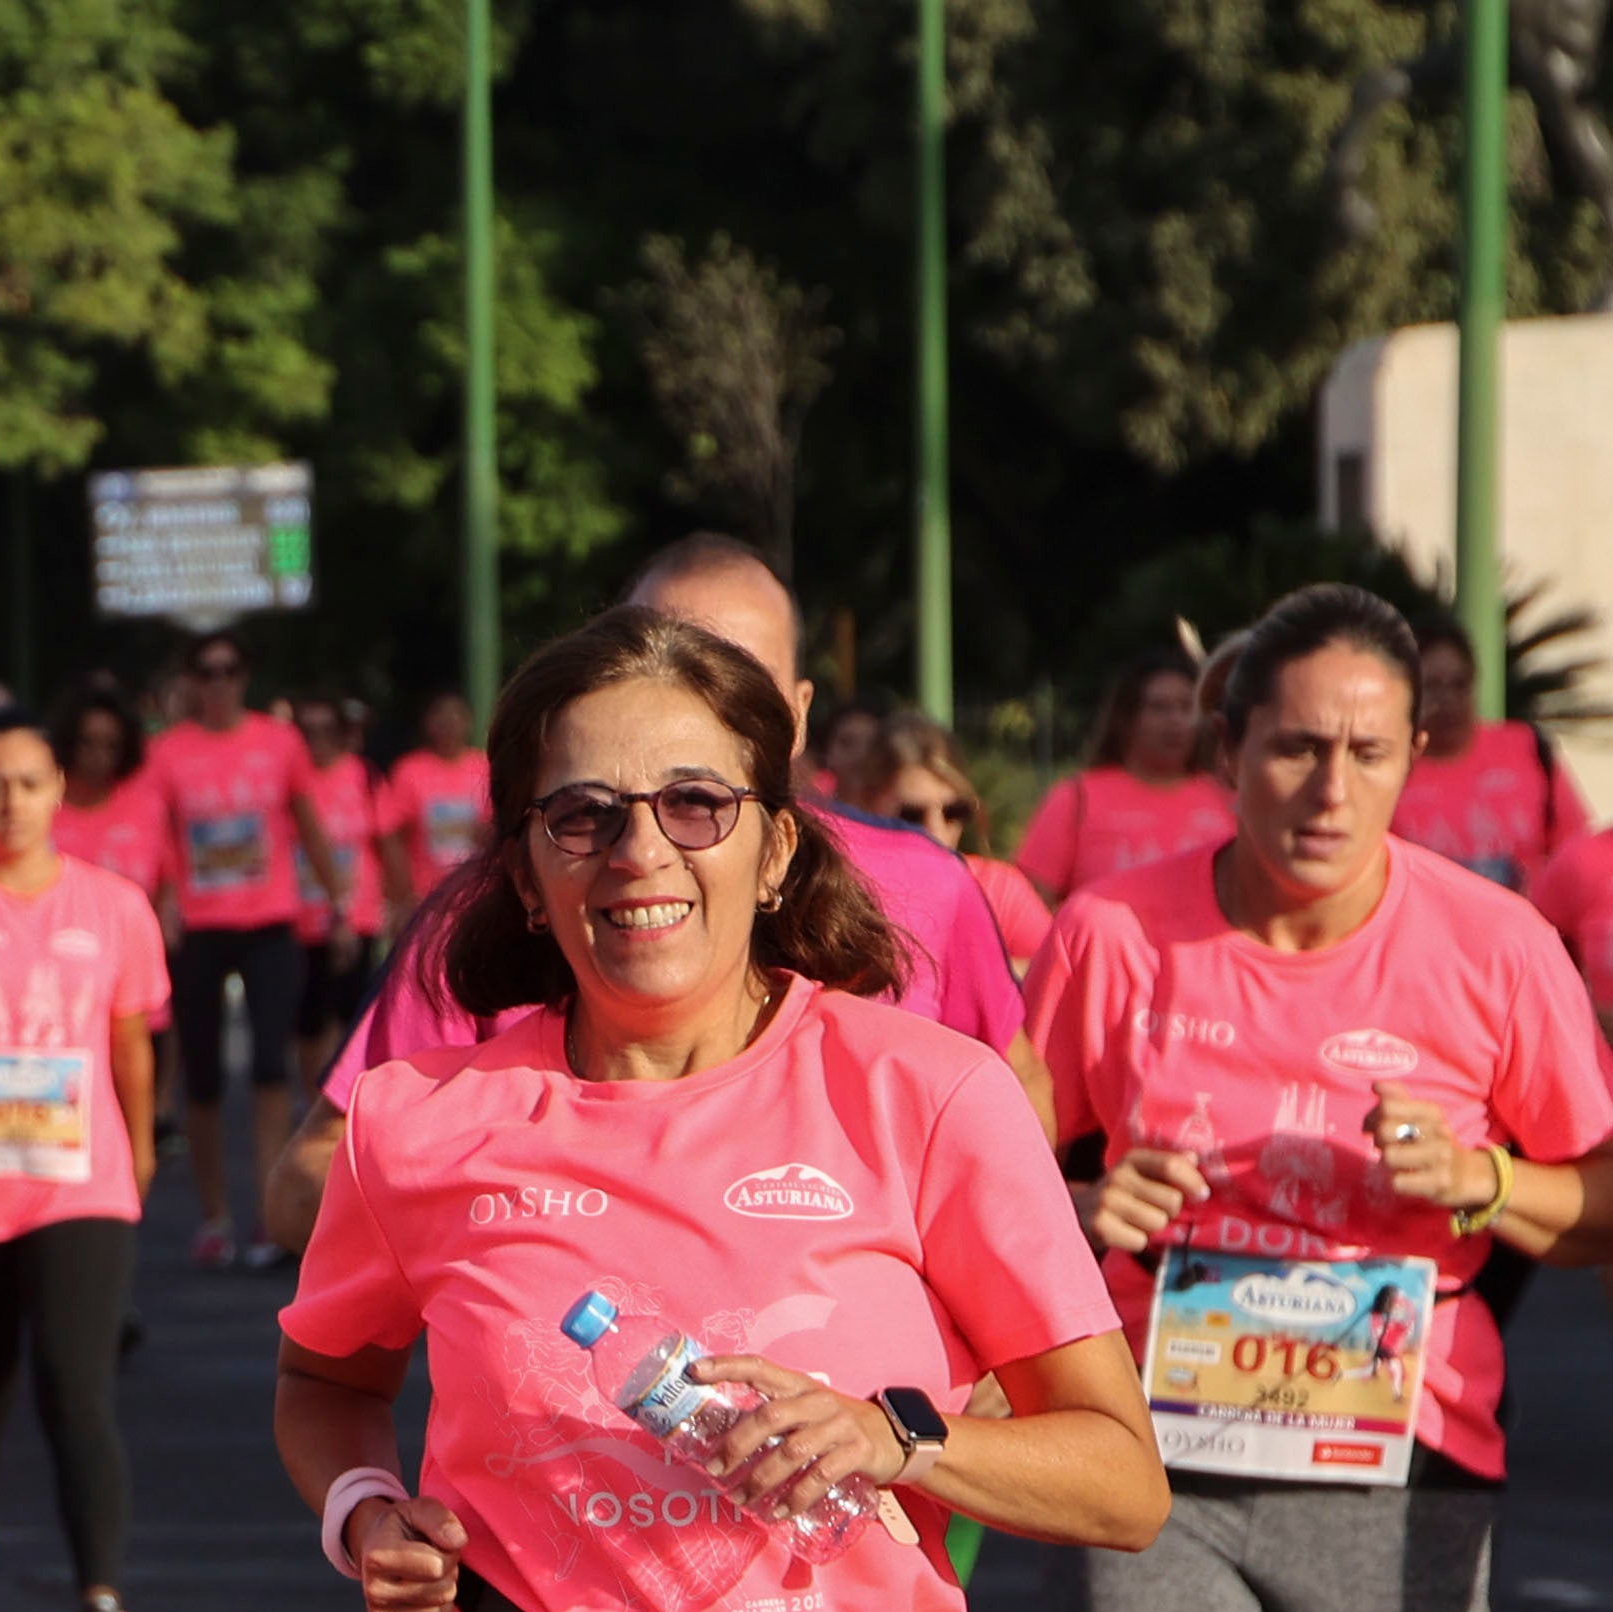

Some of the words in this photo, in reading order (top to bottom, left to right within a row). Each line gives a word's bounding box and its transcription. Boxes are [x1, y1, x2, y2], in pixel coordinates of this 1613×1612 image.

[1134, 1008, 1236, 1048] OSHO
[469, 1187, 609, 1225] OYSHO
[734, 1185, 847, 1213] ASTURIANA
[1241, 1285, 1350, 1315] ASTURIANA
[1232, 1334, 1341, 1381] 016
